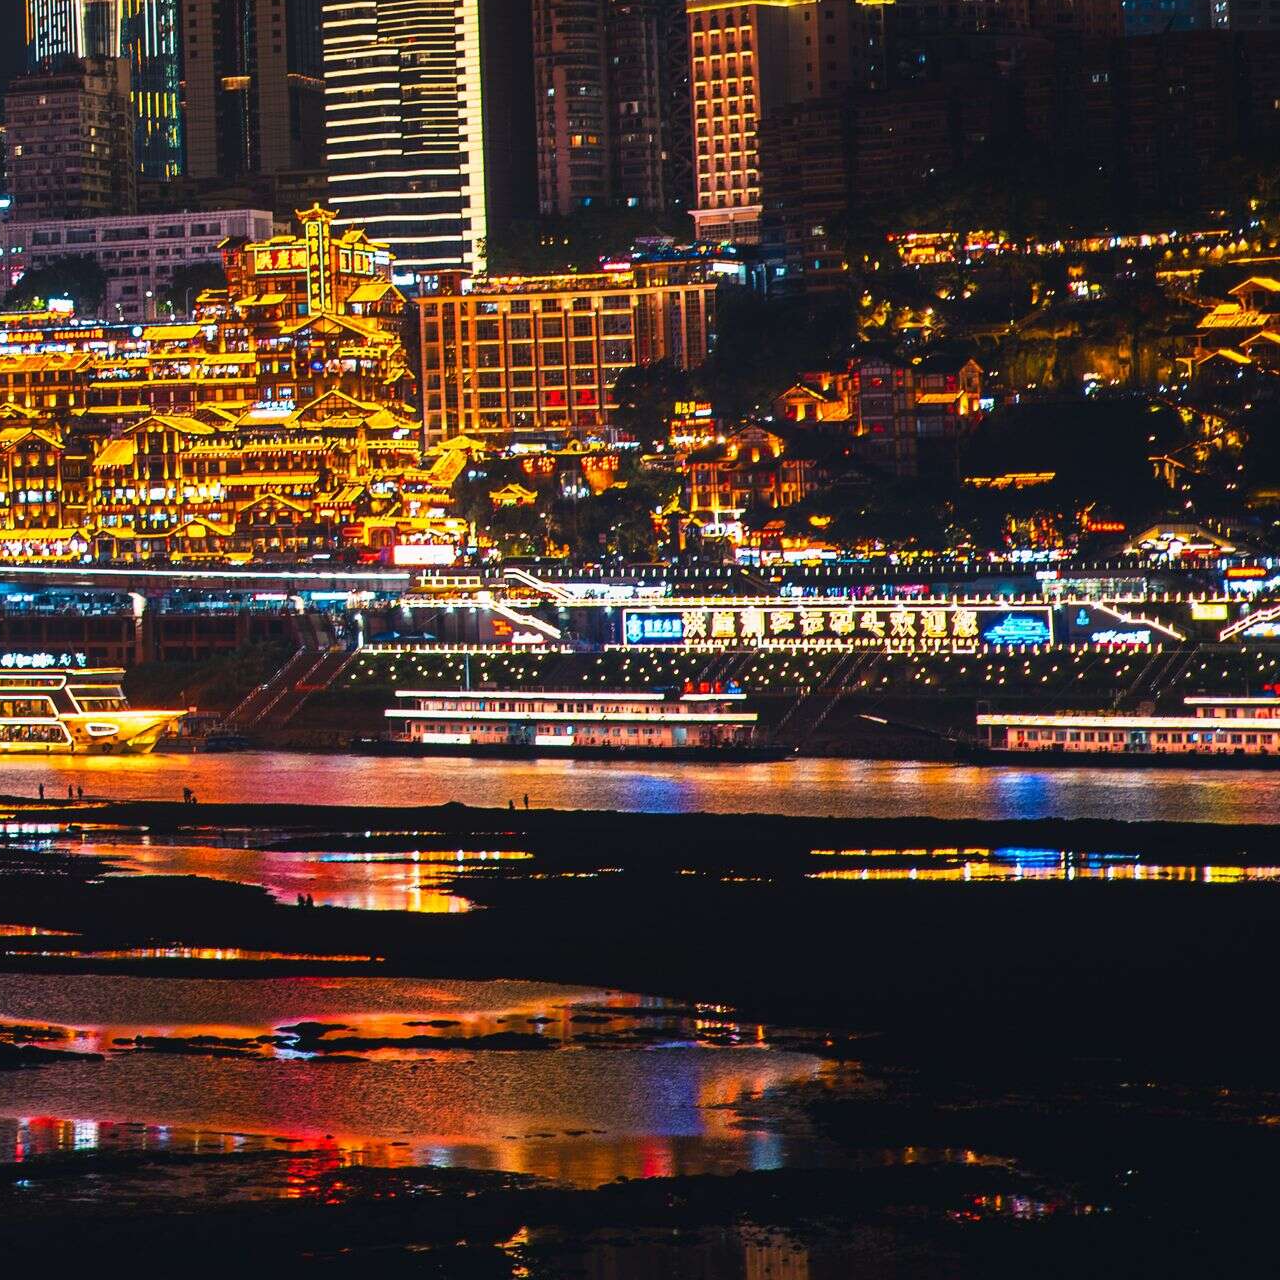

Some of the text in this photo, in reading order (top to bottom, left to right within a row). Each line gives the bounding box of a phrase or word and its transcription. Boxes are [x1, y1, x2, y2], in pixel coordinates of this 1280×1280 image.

[683, 610, 979, 638] 洪崖洞客运码头欢迎您
